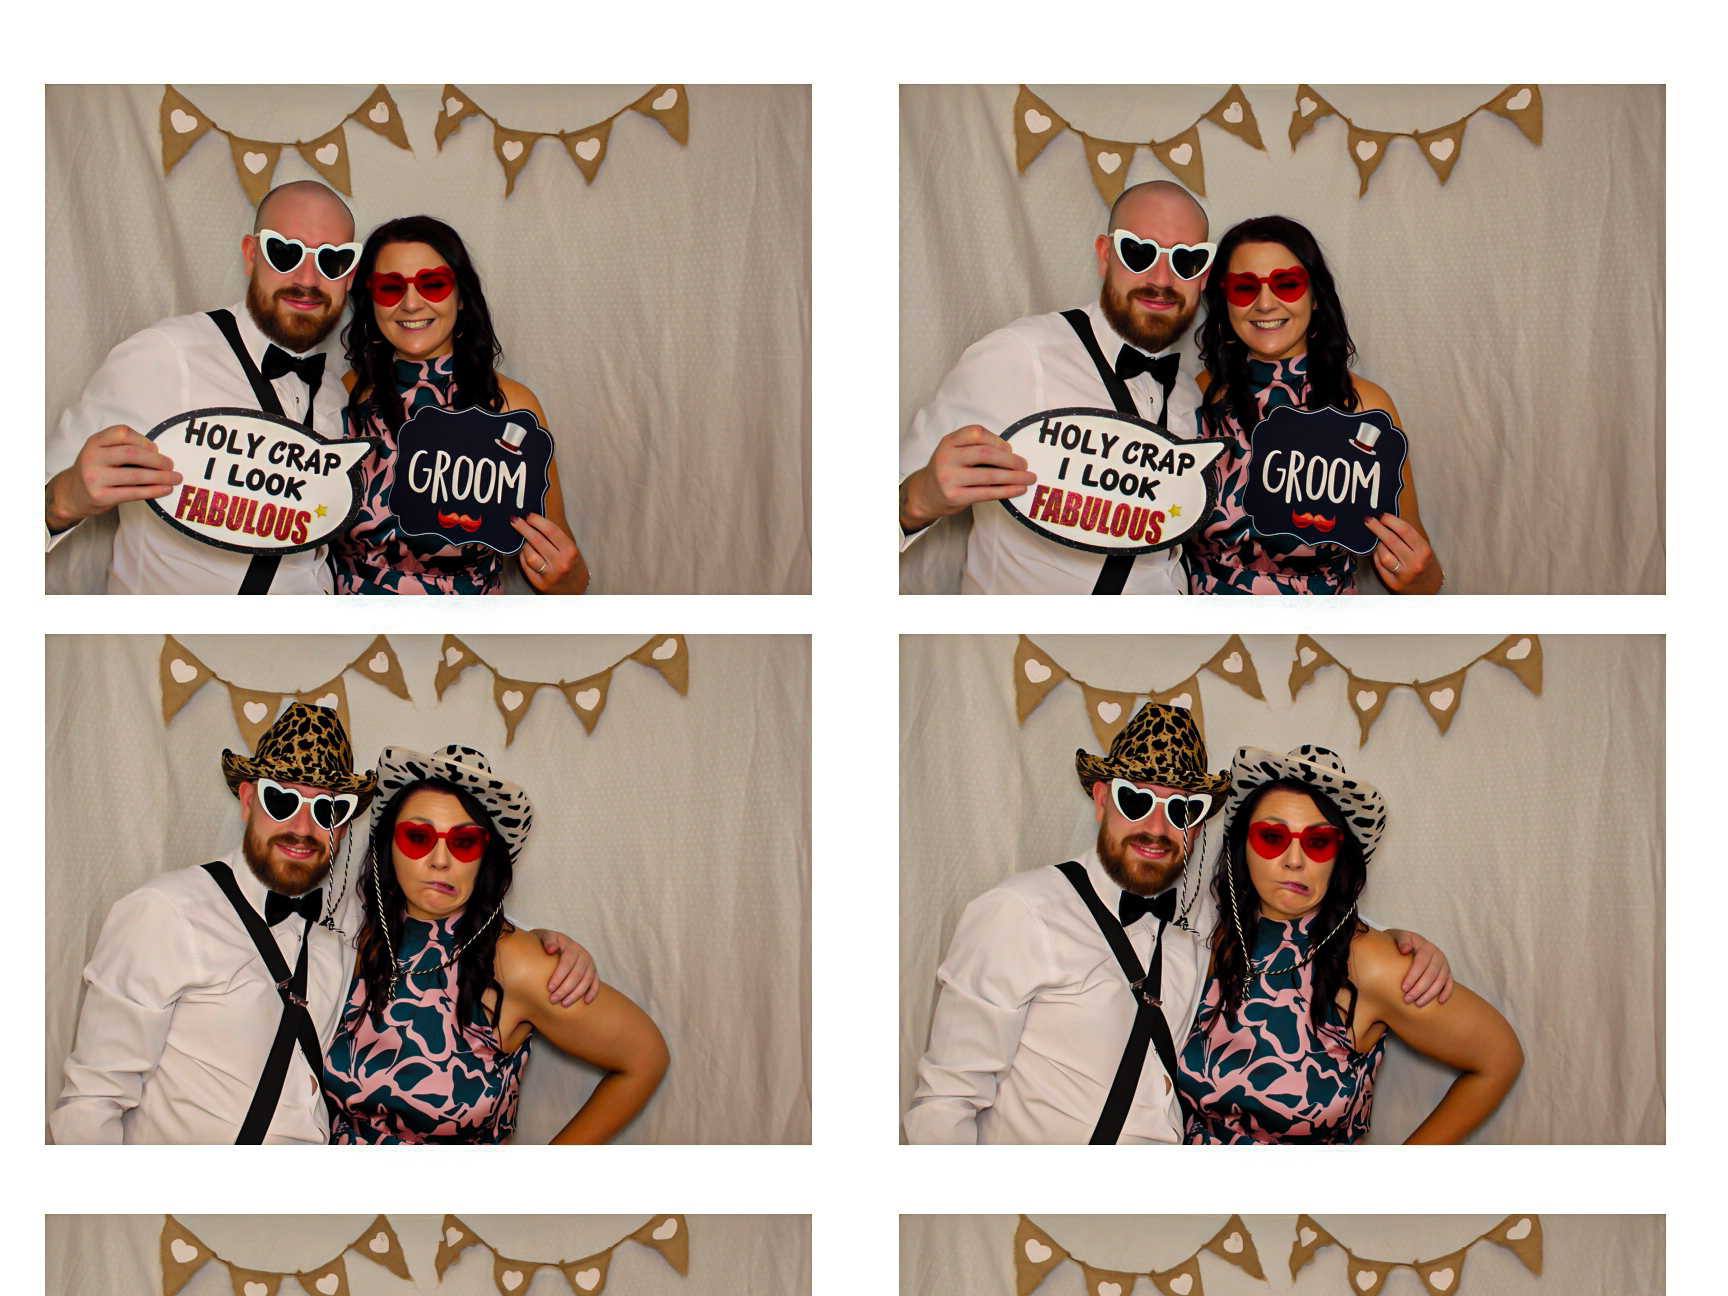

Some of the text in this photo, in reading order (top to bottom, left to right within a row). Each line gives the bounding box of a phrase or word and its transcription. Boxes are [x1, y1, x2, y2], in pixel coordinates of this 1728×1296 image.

[185, 418, 342, 477] HOLY CRAP
[1039, 418, 1196, 477] HOLY CRAP
[203, 457, 308, 502] I LOOK
[409, 450, 527, 509] GROOM
[1057, 457, 1162, 502] I LOOK
[1263, 450, 1381, 509] GROOM
[174, 484, 312, 545] FABULOUS
[1028, 484, 1166, 545] FABULOUS
